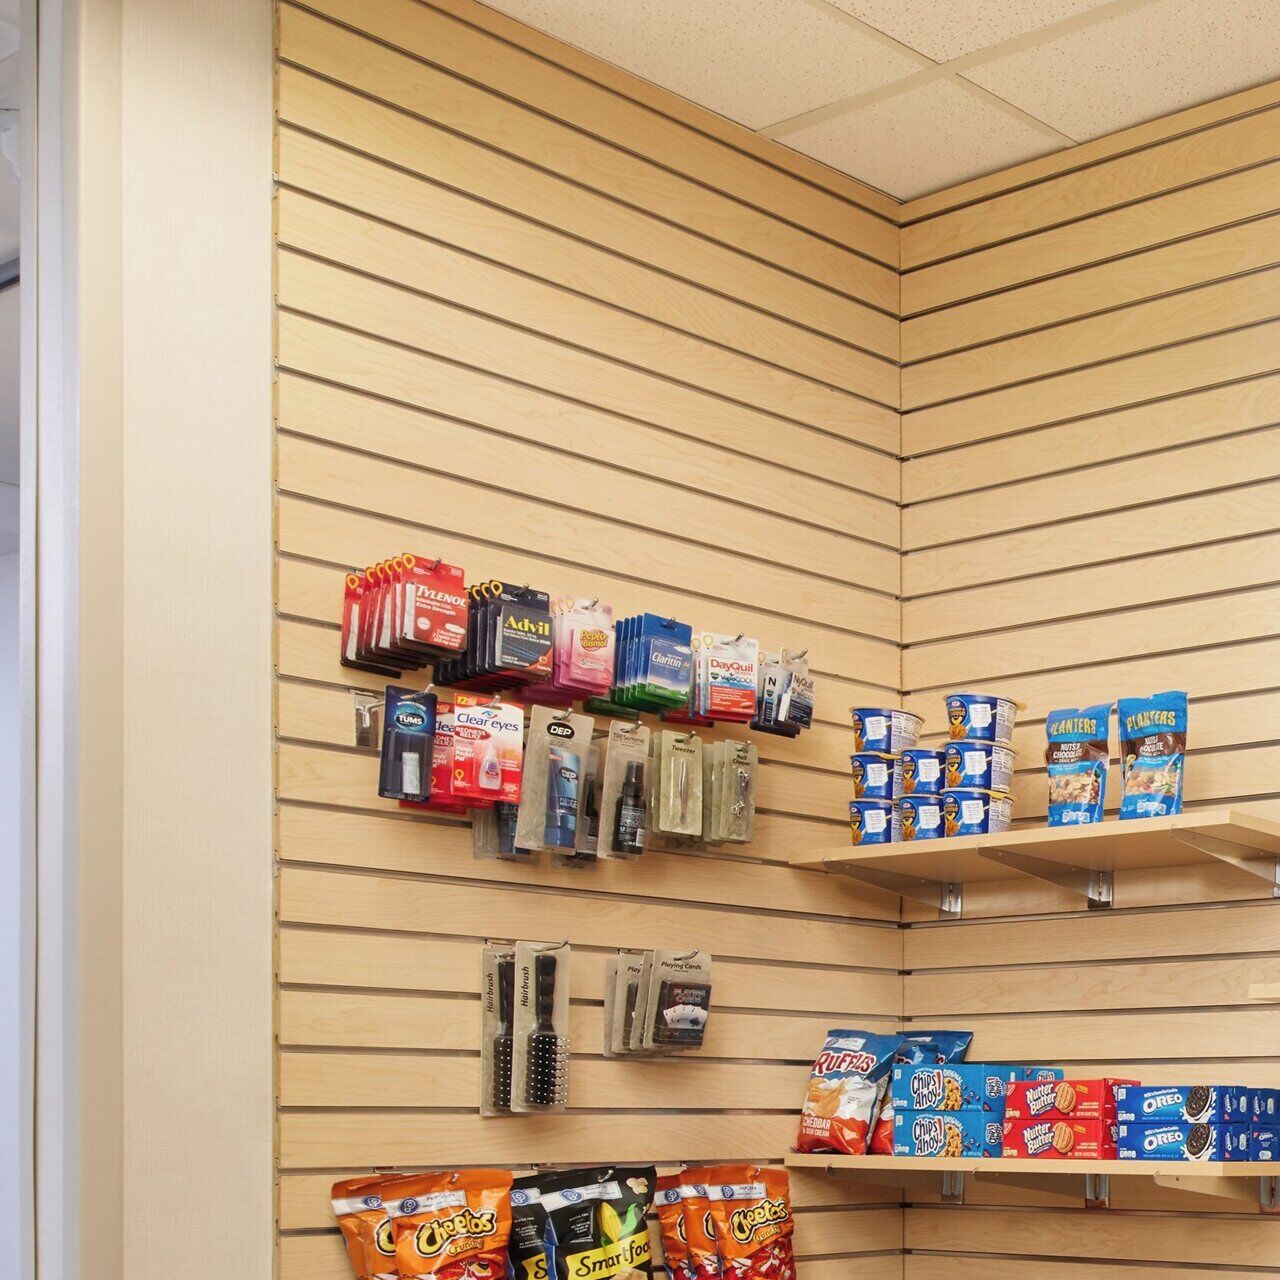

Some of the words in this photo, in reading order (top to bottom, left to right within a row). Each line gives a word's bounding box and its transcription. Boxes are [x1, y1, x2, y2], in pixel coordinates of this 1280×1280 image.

[417, 585, 466, 608] TYLENOL
[432, 606, 456, 616] Strength
[505, 616, 549, 636] Advil
[652, 652, 682, 669] Claritin
[710, 659, 753, 673] DayQuil
[399, 715, 423, 726] TUMS
[457, 713, 489, 727] Clear
[491, 719, 519, 732] eyes
[1126, 710, 1176, 733] PLANTERS
[549, 726, 571, 737] DEP
[671, 744, 696, 755] Tweezer
[661, 961, 684, 970] Playing
[685, 962, 702, 971] Cards
[520, 966, 530, 1007] Hairbrush
[812, 1051, 877, 1076] RUFFLES
[1142, 1093, 1183, 1113] OREO
[803, 1117, 831, 1129] CHEDDAR
[1143, 1132, 1183, 1151] OREO
[732, 1200, 788, 1238] Cheetos
[415, 1207, 495, 1256] Cheetos
